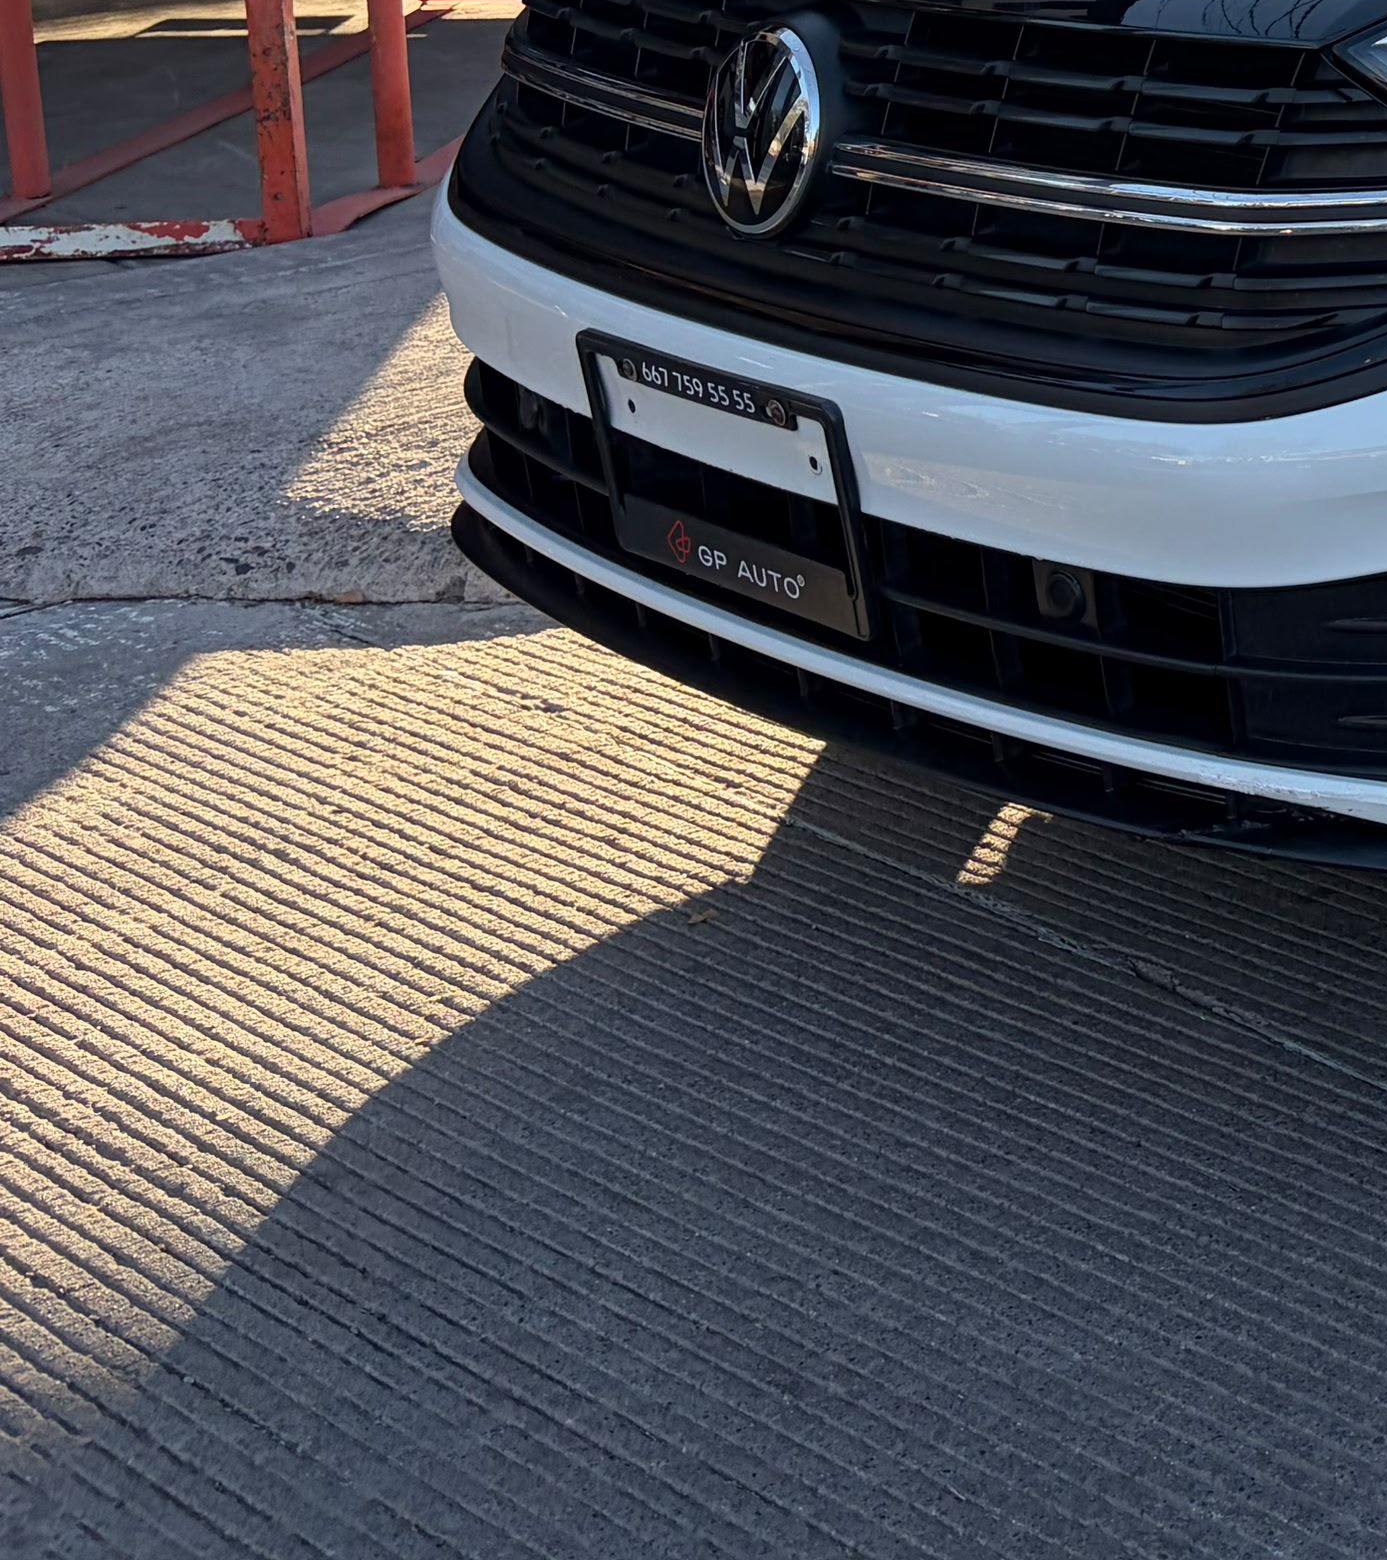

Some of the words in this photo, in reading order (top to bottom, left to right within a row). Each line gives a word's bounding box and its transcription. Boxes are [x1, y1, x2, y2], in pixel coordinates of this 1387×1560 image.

[642, 362, 668, 387] 667
[672, 372, 703, 398] 759
[708, 382, 730, 406] 55
[733, 390, 755, 413] 55
[698, 545, 727, 570] GP
